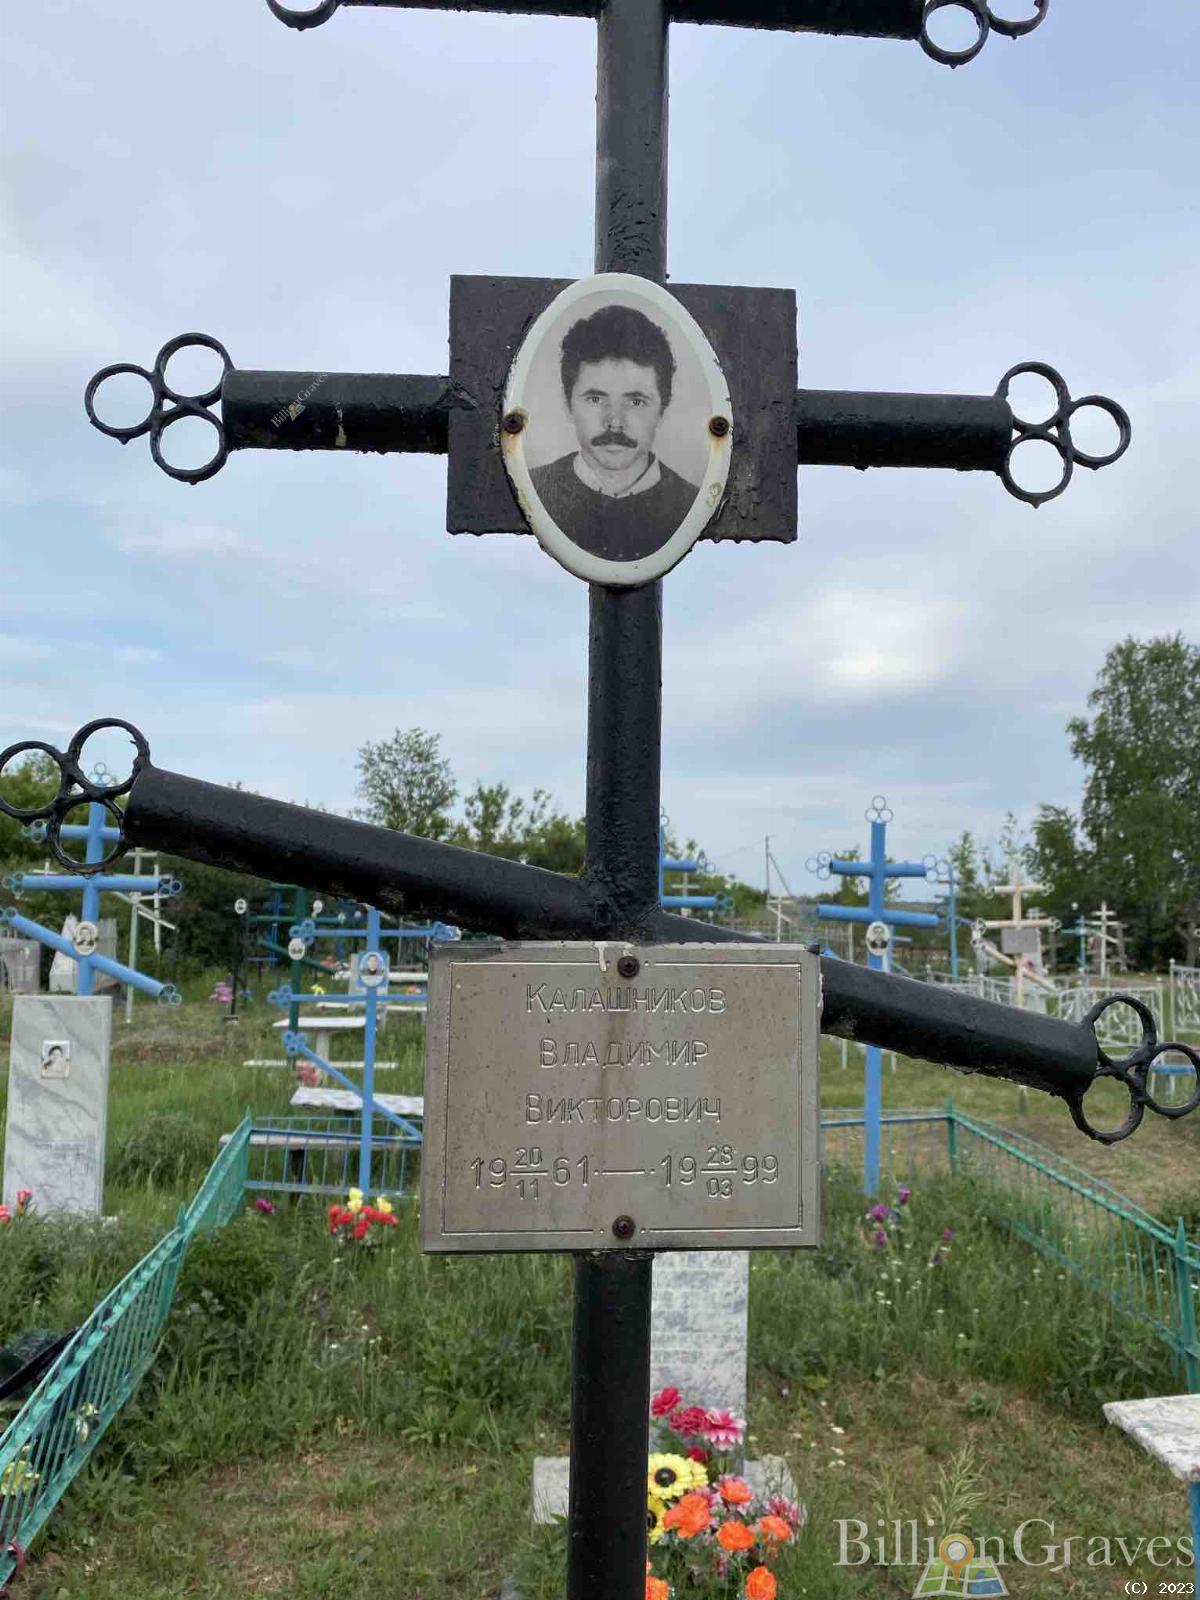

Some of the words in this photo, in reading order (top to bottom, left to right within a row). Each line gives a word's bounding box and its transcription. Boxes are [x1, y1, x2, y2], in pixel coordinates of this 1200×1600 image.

[525, 982, 728, 1014] КАЛАШНИКОВ
[539, 1038, 709, 1068] ВЛАДИМИР
[525, 1093, 722, 1125] ВИКТОРОВИЧ
[515, 1146, 543, 1168] 20
[515, 1178, 539, 1200] 11
[706, 1177, 734, 1199] 03
